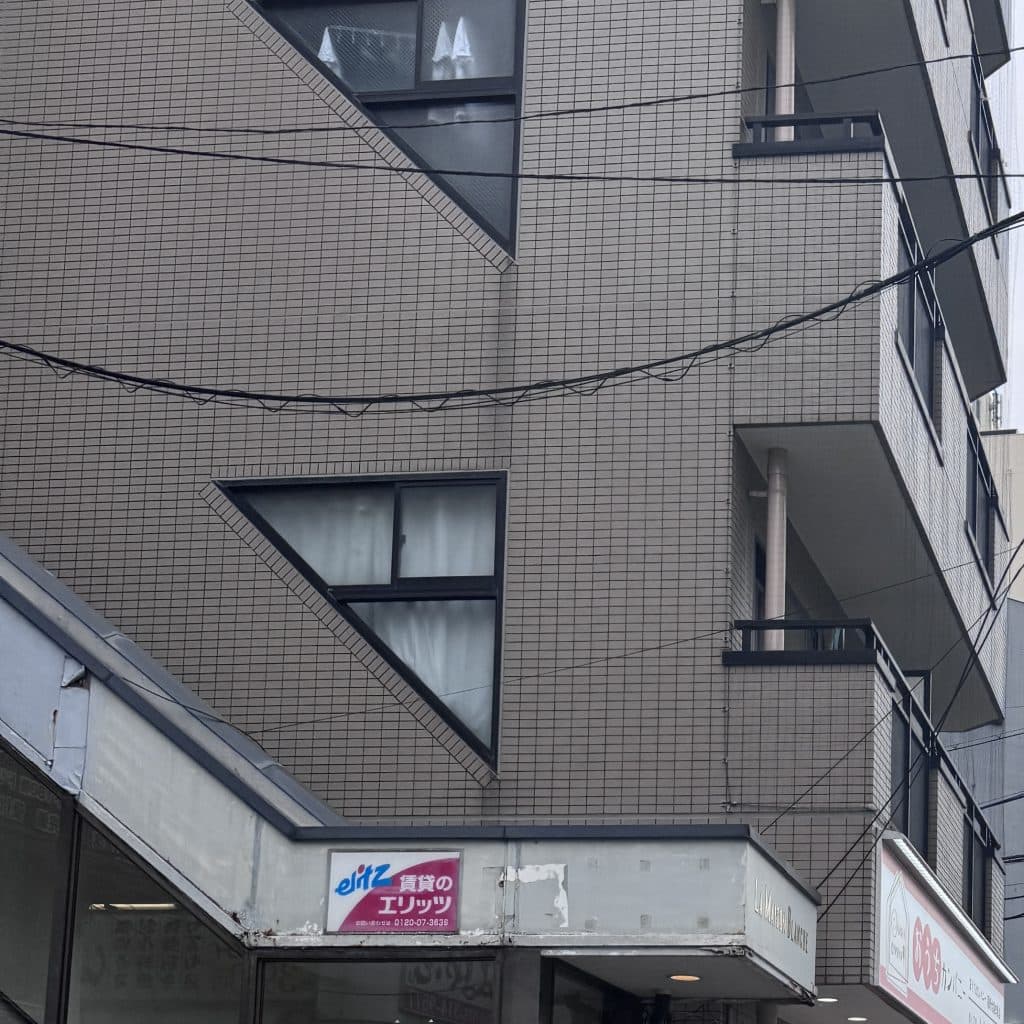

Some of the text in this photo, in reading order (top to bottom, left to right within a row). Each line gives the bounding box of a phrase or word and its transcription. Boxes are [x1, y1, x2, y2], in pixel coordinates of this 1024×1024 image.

[335, 864, 393, 896] elitz
[400, 875, 453, 892] 賃貸の
[378, 896, 452, 914] エリッツ
